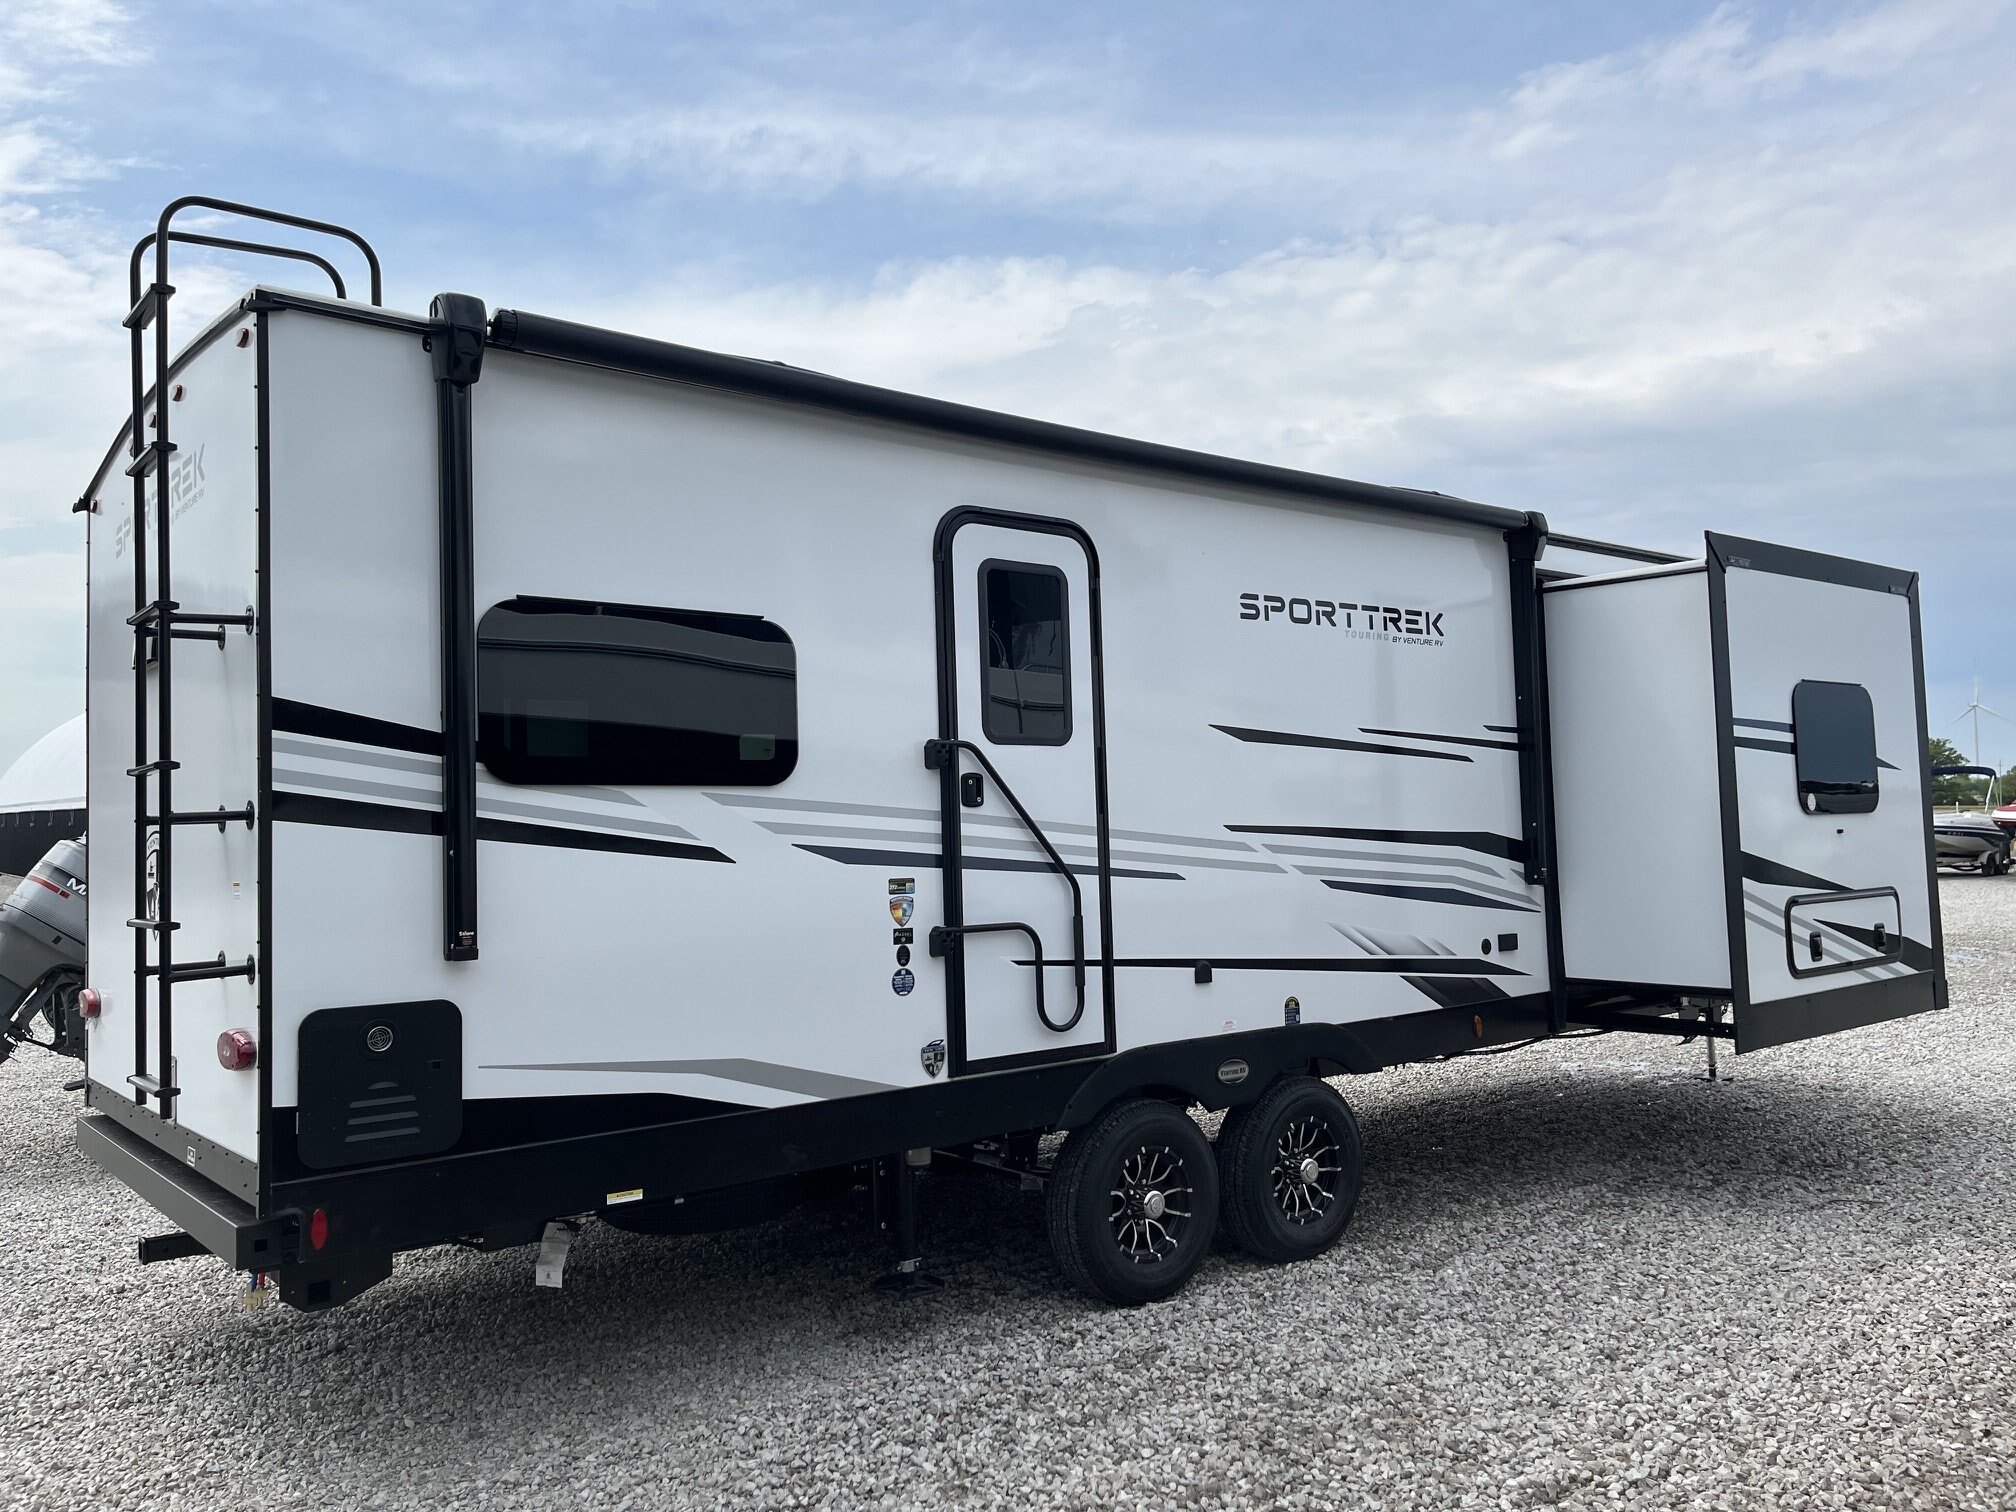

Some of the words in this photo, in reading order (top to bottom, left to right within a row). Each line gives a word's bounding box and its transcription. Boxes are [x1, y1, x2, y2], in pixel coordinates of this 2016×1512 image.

[116, 442, 206, 560] SPRTREK
[1239, 592, 1445, 637] SPORTTREK
[1344, 629, 1390, 641] TOURING
[1392, 635, 1403, 643] BY
[1402, 636, 1434, 646] VENTURE
[1434, 639, 1444, 647] RV
